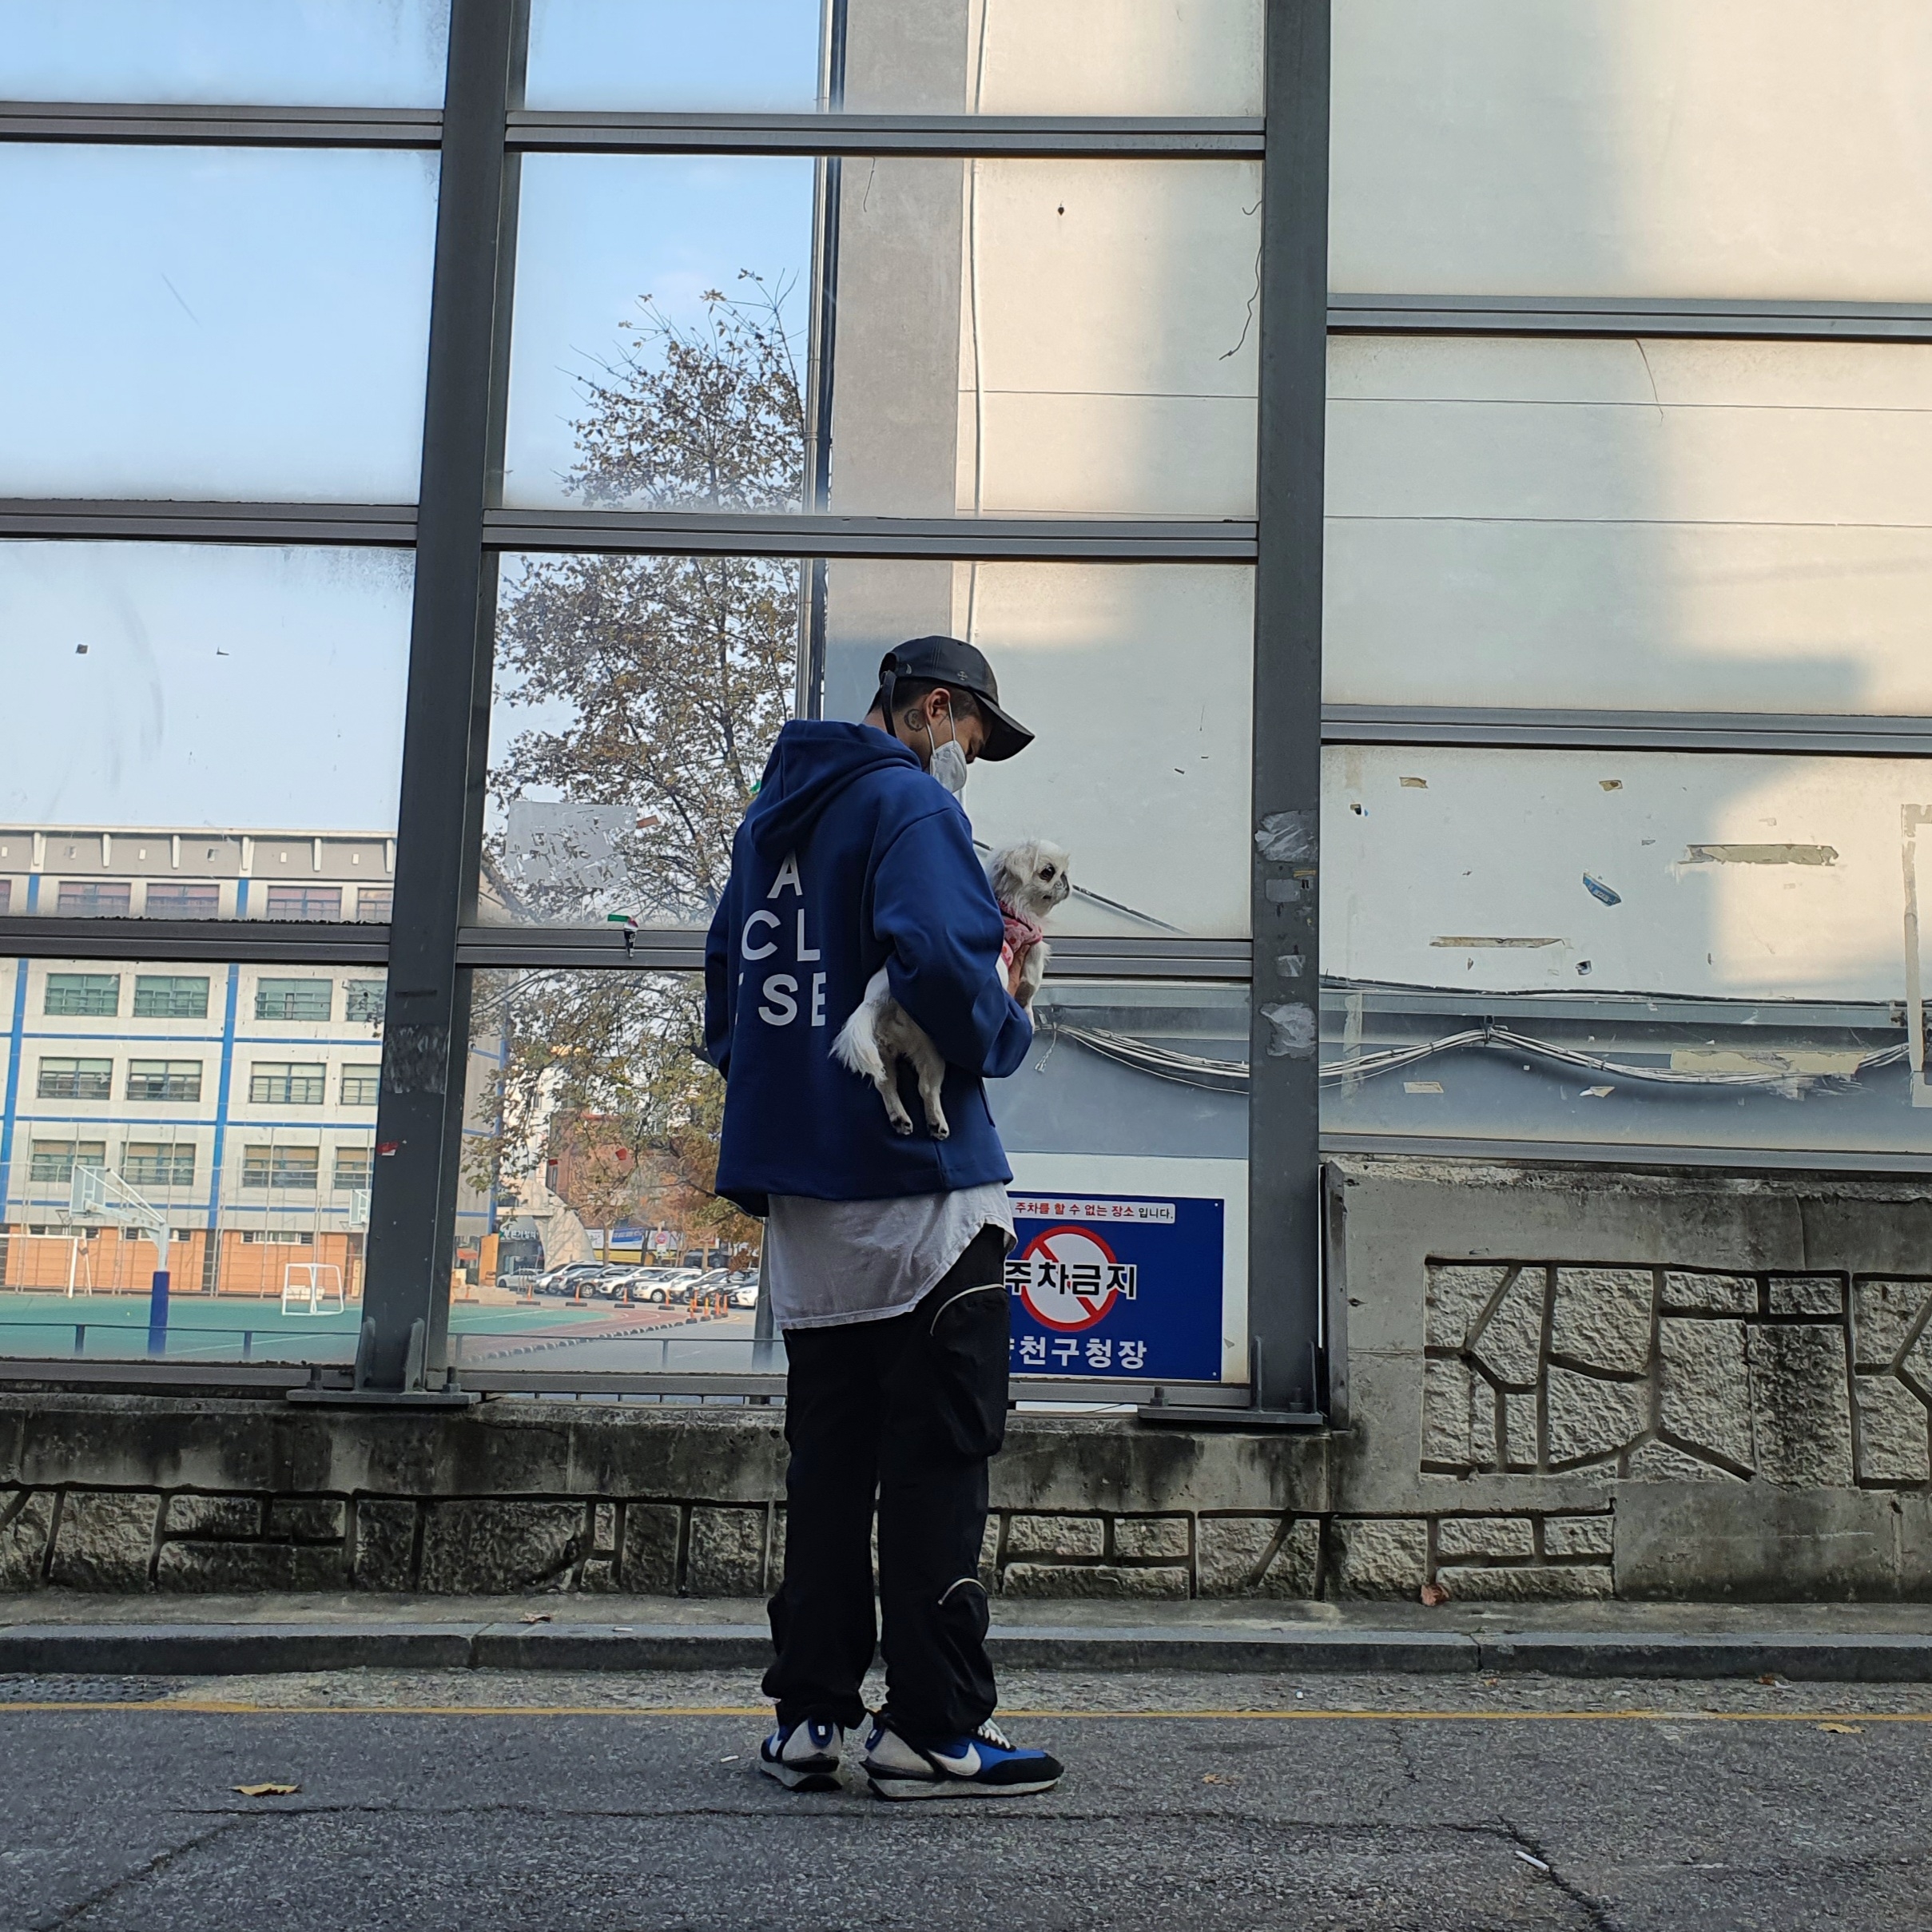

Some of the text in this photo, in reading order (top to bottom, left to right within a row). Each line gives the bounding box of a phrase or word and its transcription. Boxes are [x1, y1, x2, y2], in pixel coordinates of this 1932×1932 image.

[1015, 1202, 1173, 1219] 주차를 할 수 없는 장소 입니다.
[1005, 1262, 1135, 1298] 주차금지
